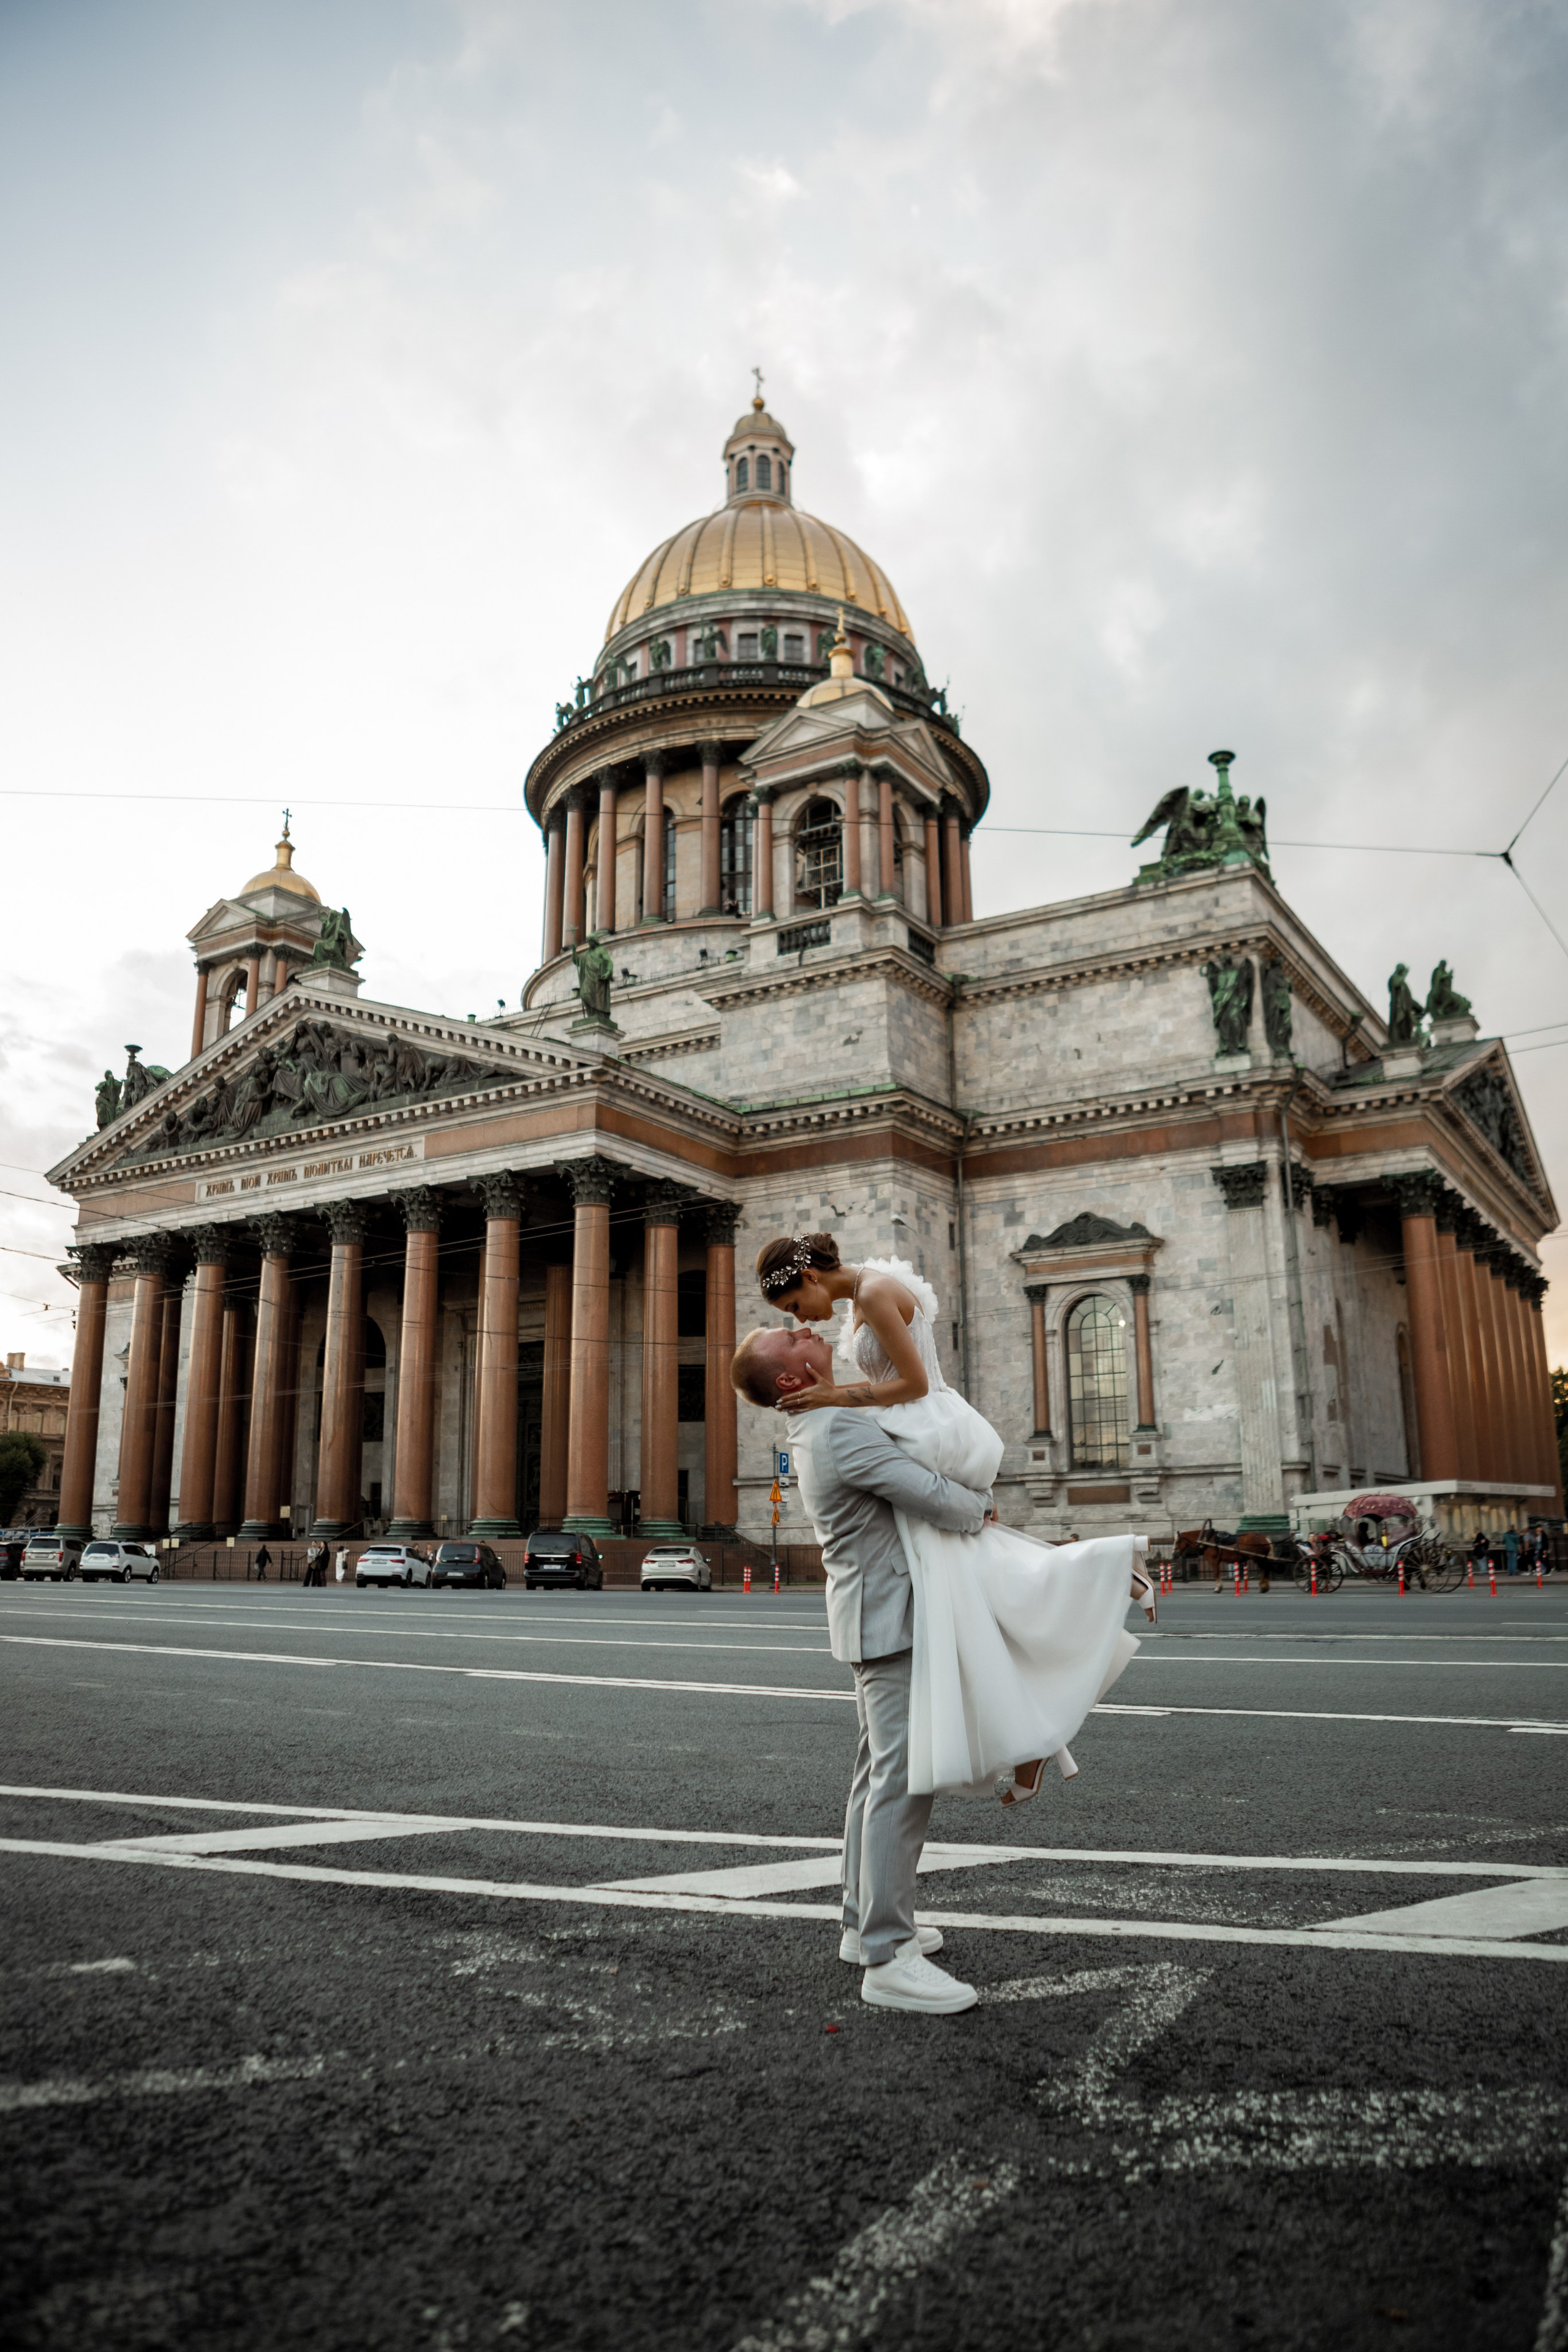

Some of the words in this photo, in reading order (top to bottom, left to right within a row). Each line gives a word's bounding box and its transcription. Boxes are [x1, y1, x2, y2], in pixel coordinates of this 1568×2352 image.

[206, 1180, 235, 1197] ХРАМЪ
[266, 1168, 297, 1185] ХРАМЪ
[782, 1455, 788, 1472] P
